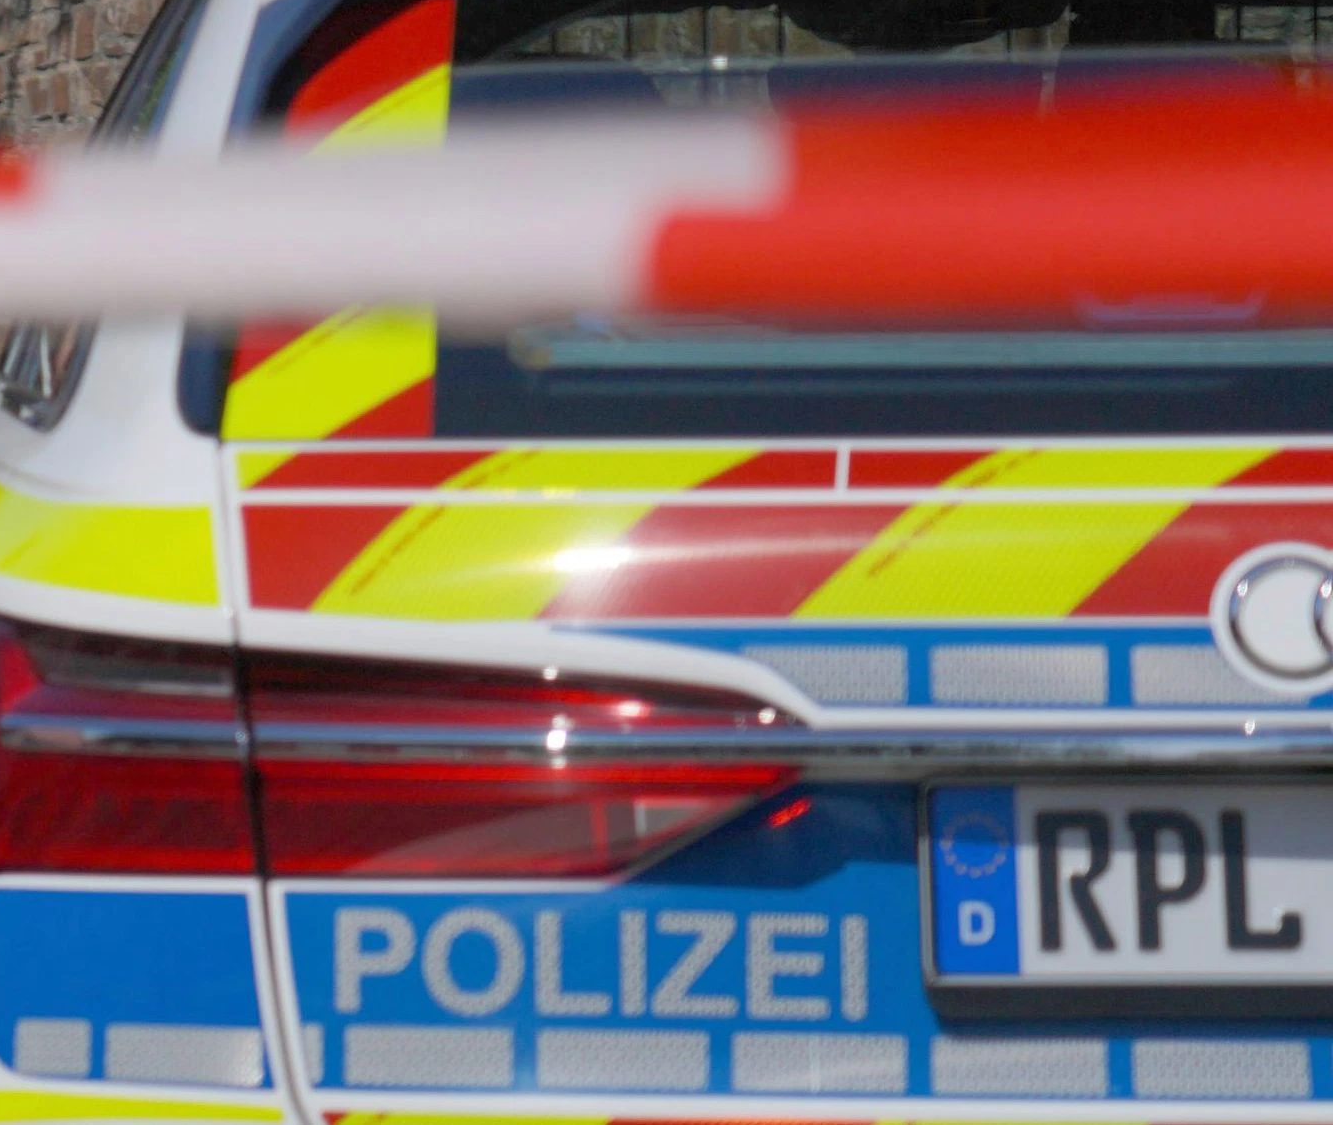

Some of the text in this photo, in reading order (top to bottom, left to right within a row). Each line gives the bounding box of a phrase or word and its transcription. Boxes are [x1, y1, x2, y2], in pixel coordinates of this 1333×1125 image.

[958, 901, 997, 945] D
[1035, 808, 1302, 952] RPL
[334, 906, 869, 1021] POLIZEI
